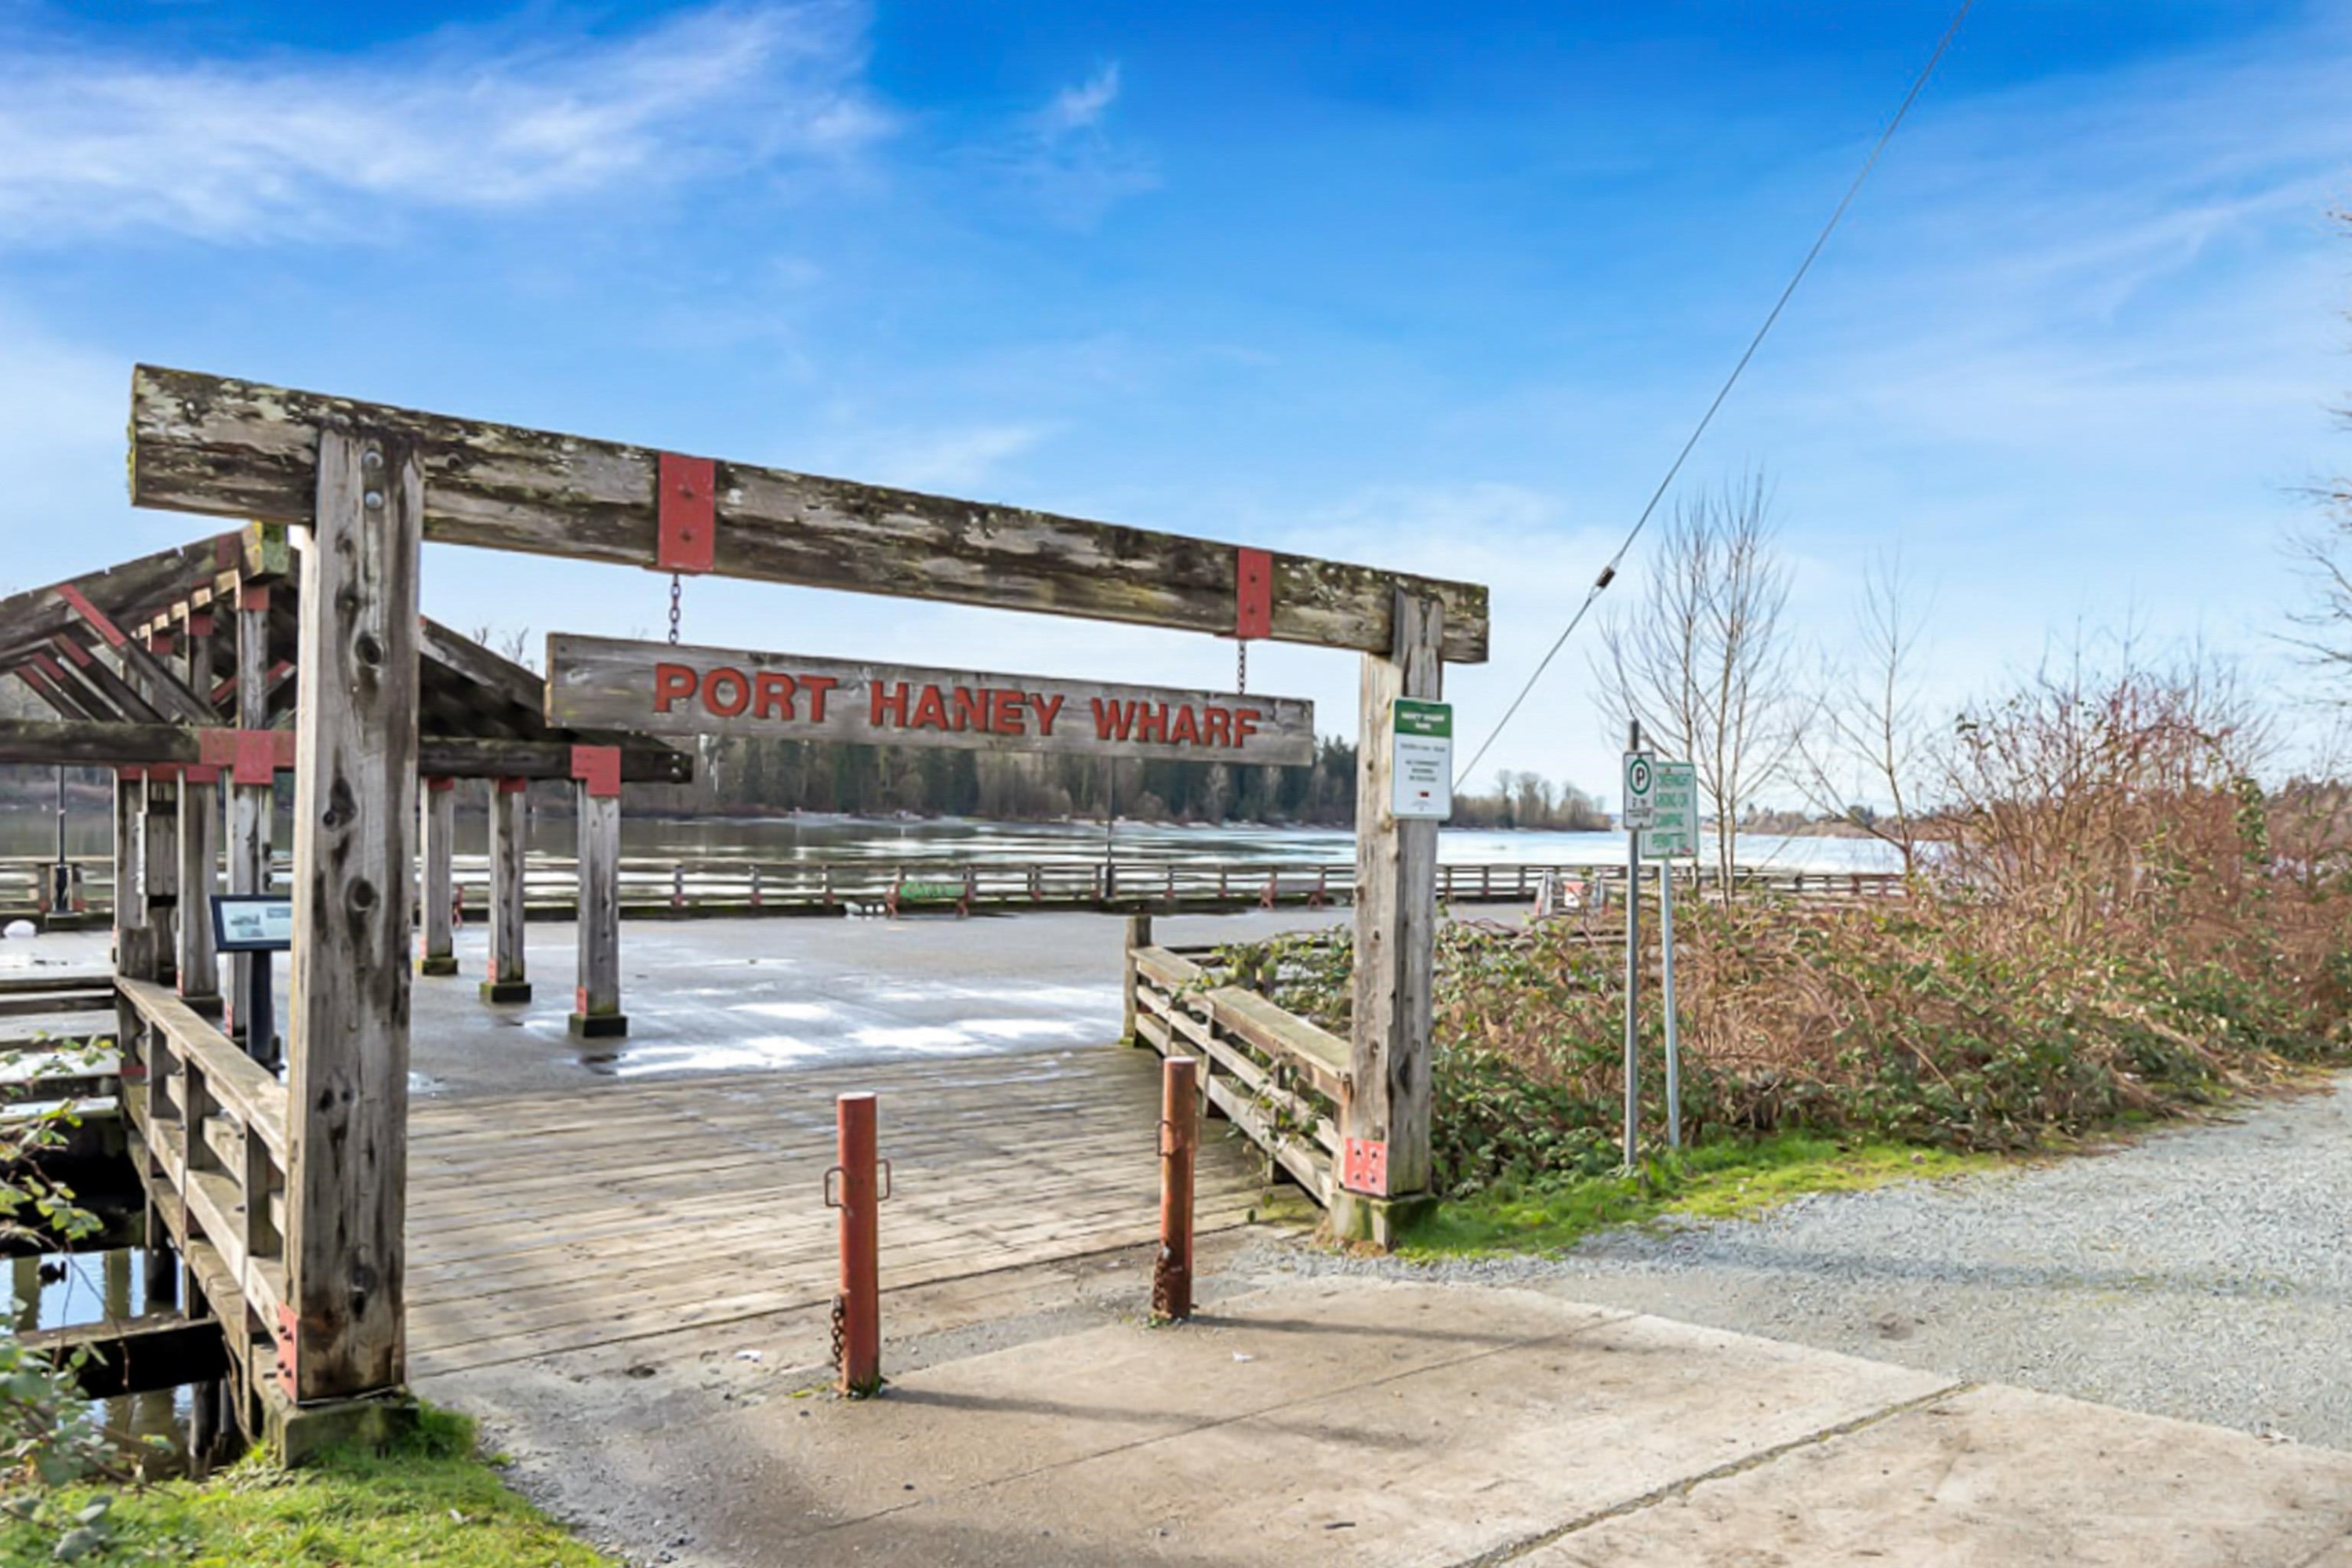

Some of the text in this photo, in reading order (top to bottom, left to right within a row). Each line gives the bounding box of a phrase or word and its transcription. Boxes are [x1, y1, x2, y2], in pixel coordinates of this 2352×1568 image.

[654, 662, 1262, 749] PORT HANEY WHARF
[1635, 767, 1645, 786] P
